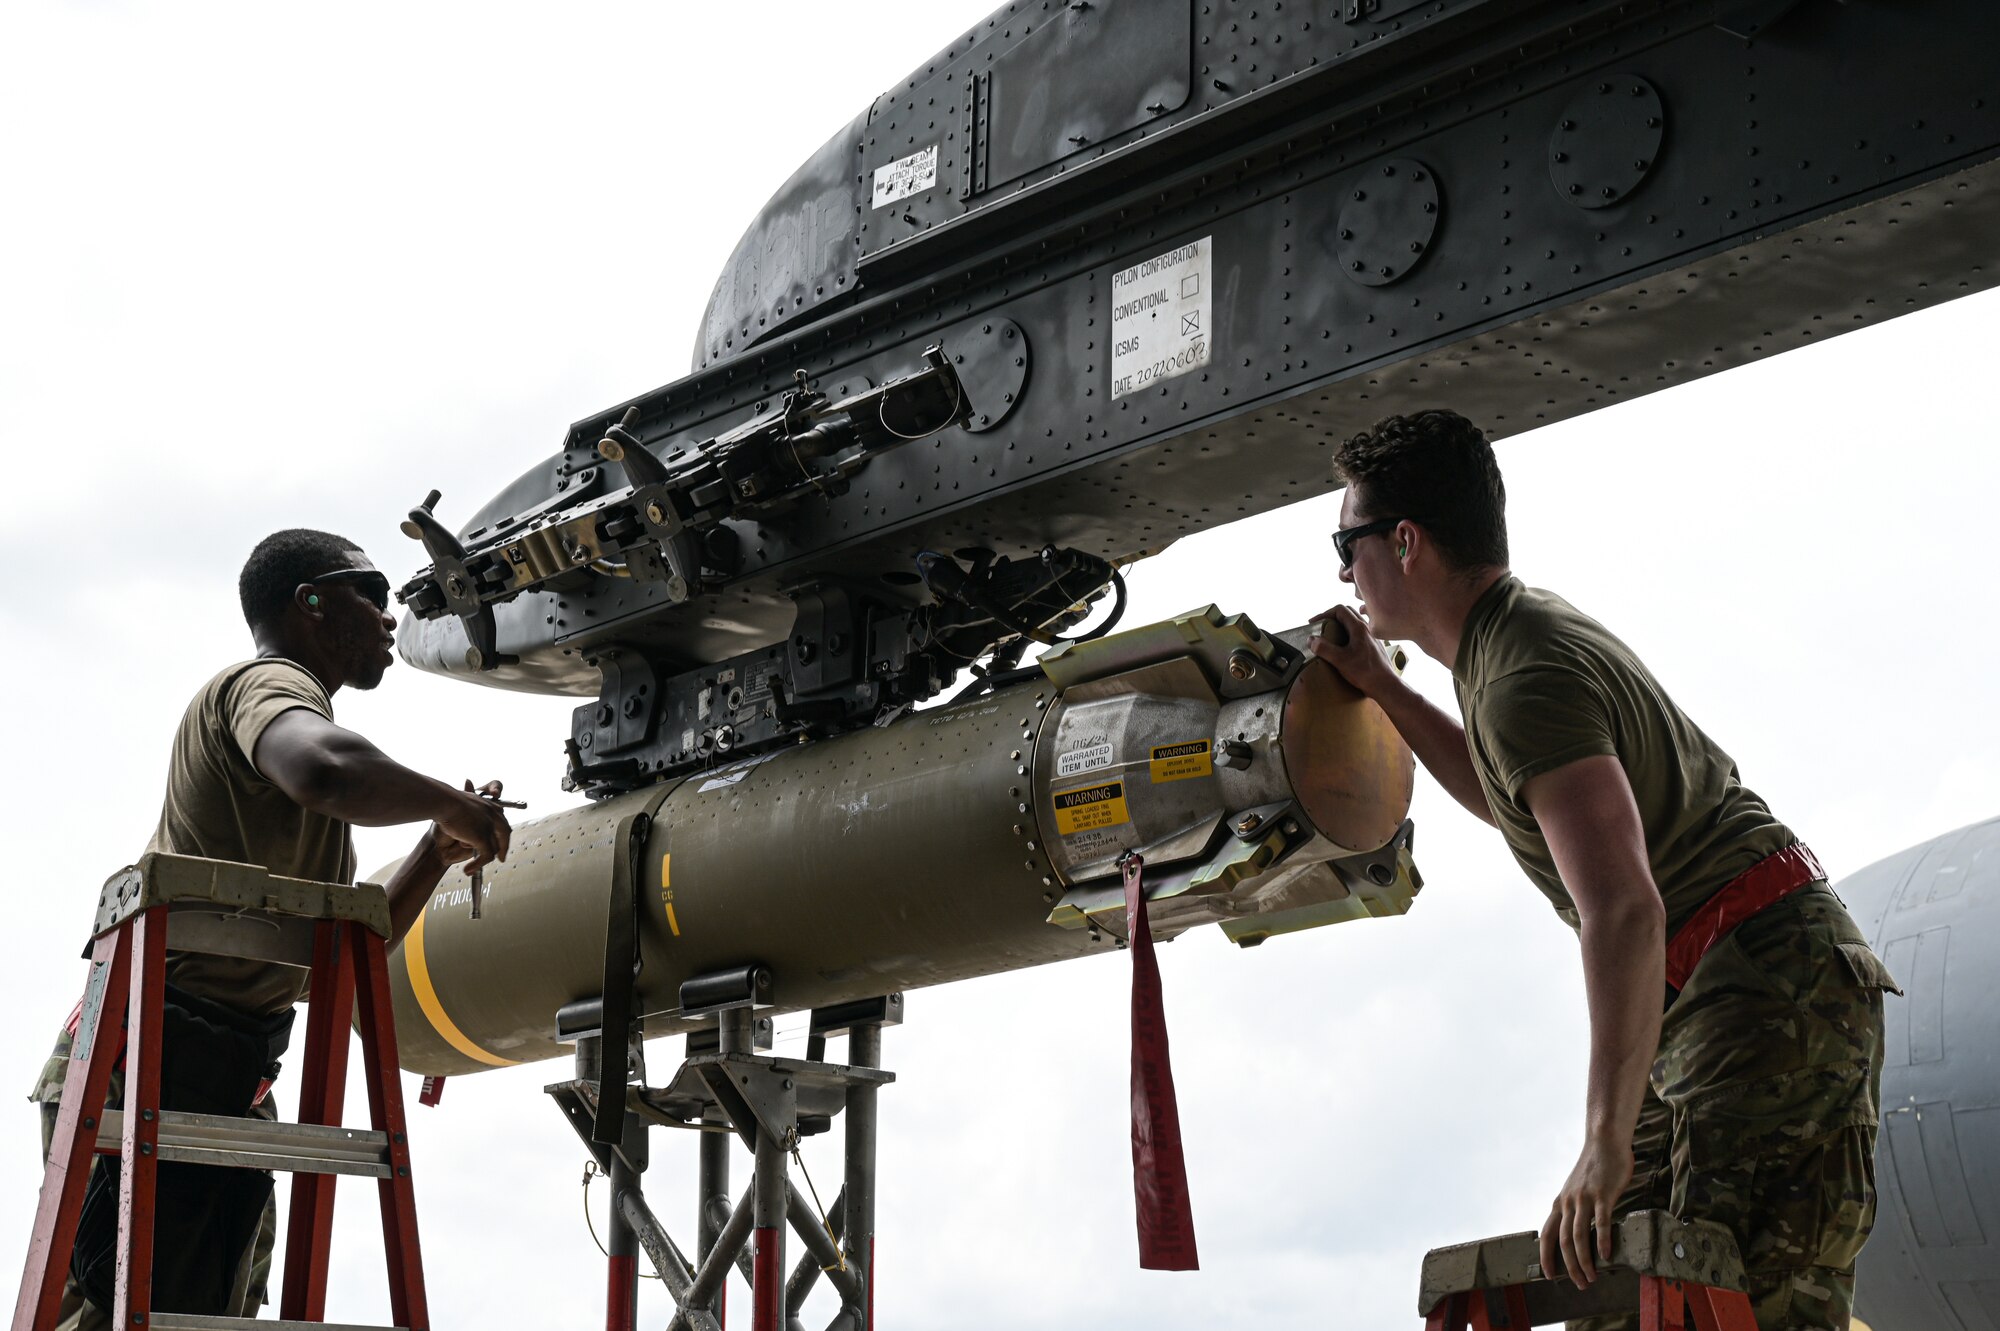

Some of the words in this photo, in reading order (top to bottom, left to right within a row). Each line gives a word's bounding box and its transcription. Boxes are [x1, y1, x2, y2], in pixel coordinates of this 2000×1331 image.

[888, 168, 910, 182] ATTACH
[912, 158, 936, 173] TORQUE
[1114, 266, 1139, 289] PYLON
[1141, 242, 1199, 278] CONFIGURATION
[1114, 289, 1169, 322] CONVENTIONAL
[1115, 336, 1139, 358] ICSMS
[1114, 376, 1133, 395] DATE
[1061, 745, 1110, 764] WARRANTED
[1158, 743, 1203, 758] WARNING
[1062, 762, 1081, 774] ITEM
[1085, 756, 1108, 768] UNTIL
[1064, 787, 1111, 807] WARNING
[1085, 805, 1099, 814] LOADED
[661, 889, 674, 901] CG
